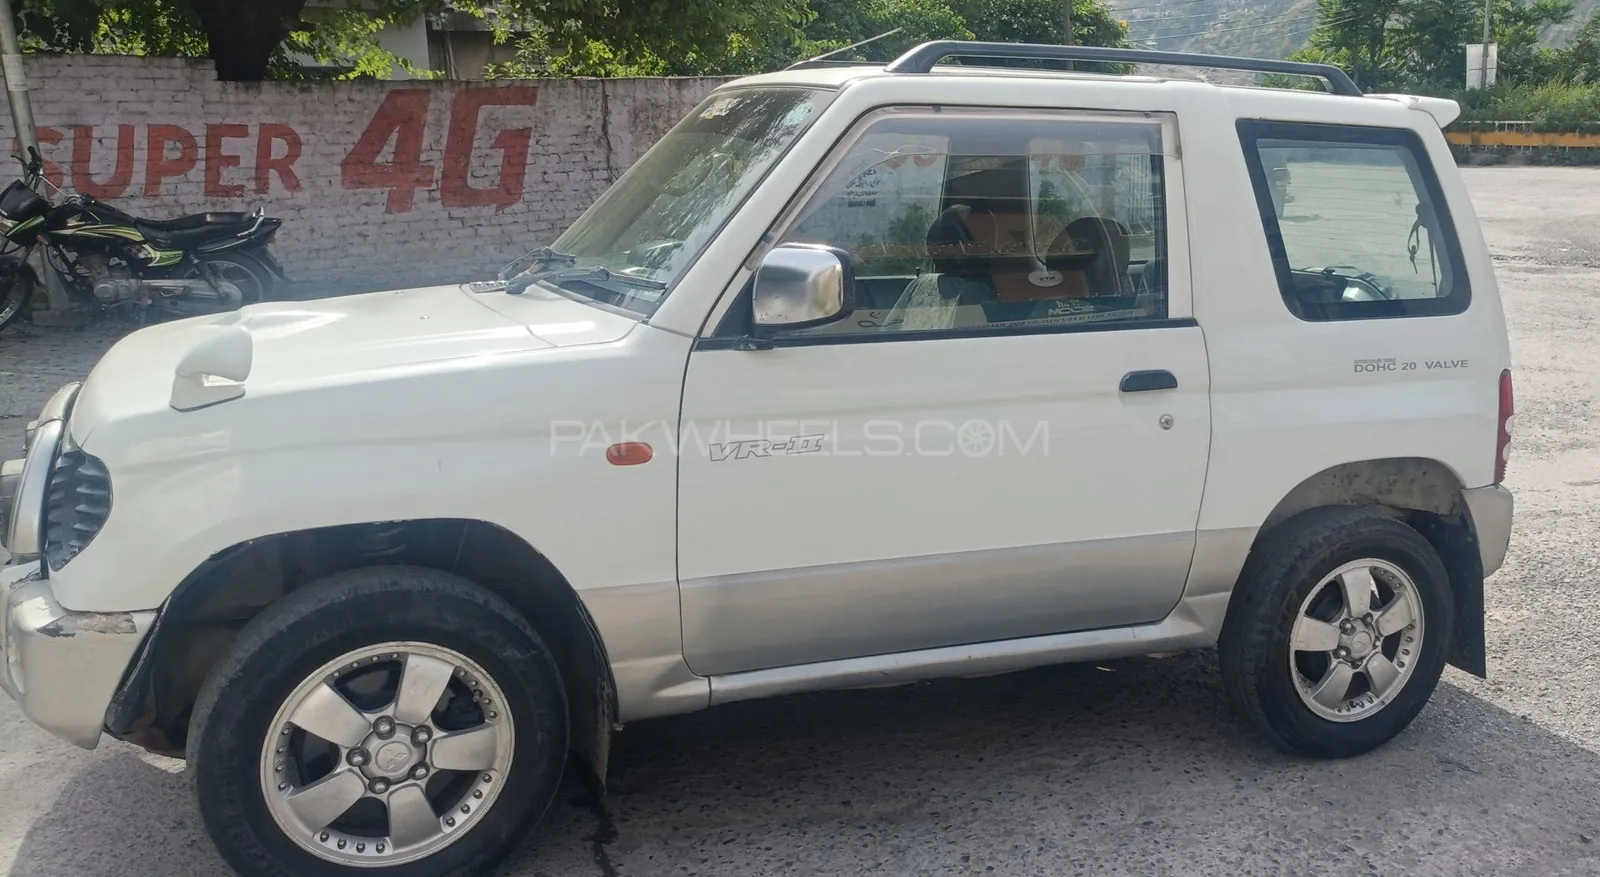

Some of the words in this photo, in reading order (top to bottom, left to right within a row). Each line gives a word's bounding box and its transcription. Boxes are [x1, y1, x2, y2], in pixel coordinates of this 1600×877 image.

[12, 123, 302, 200] SUPER
[340, 86, 539, 215] 4G
[1353, 362, 1398, 373] DOHC
[1400, 361, 1417, 371] 20
[1424, 359, 1469, 369] VALVE
